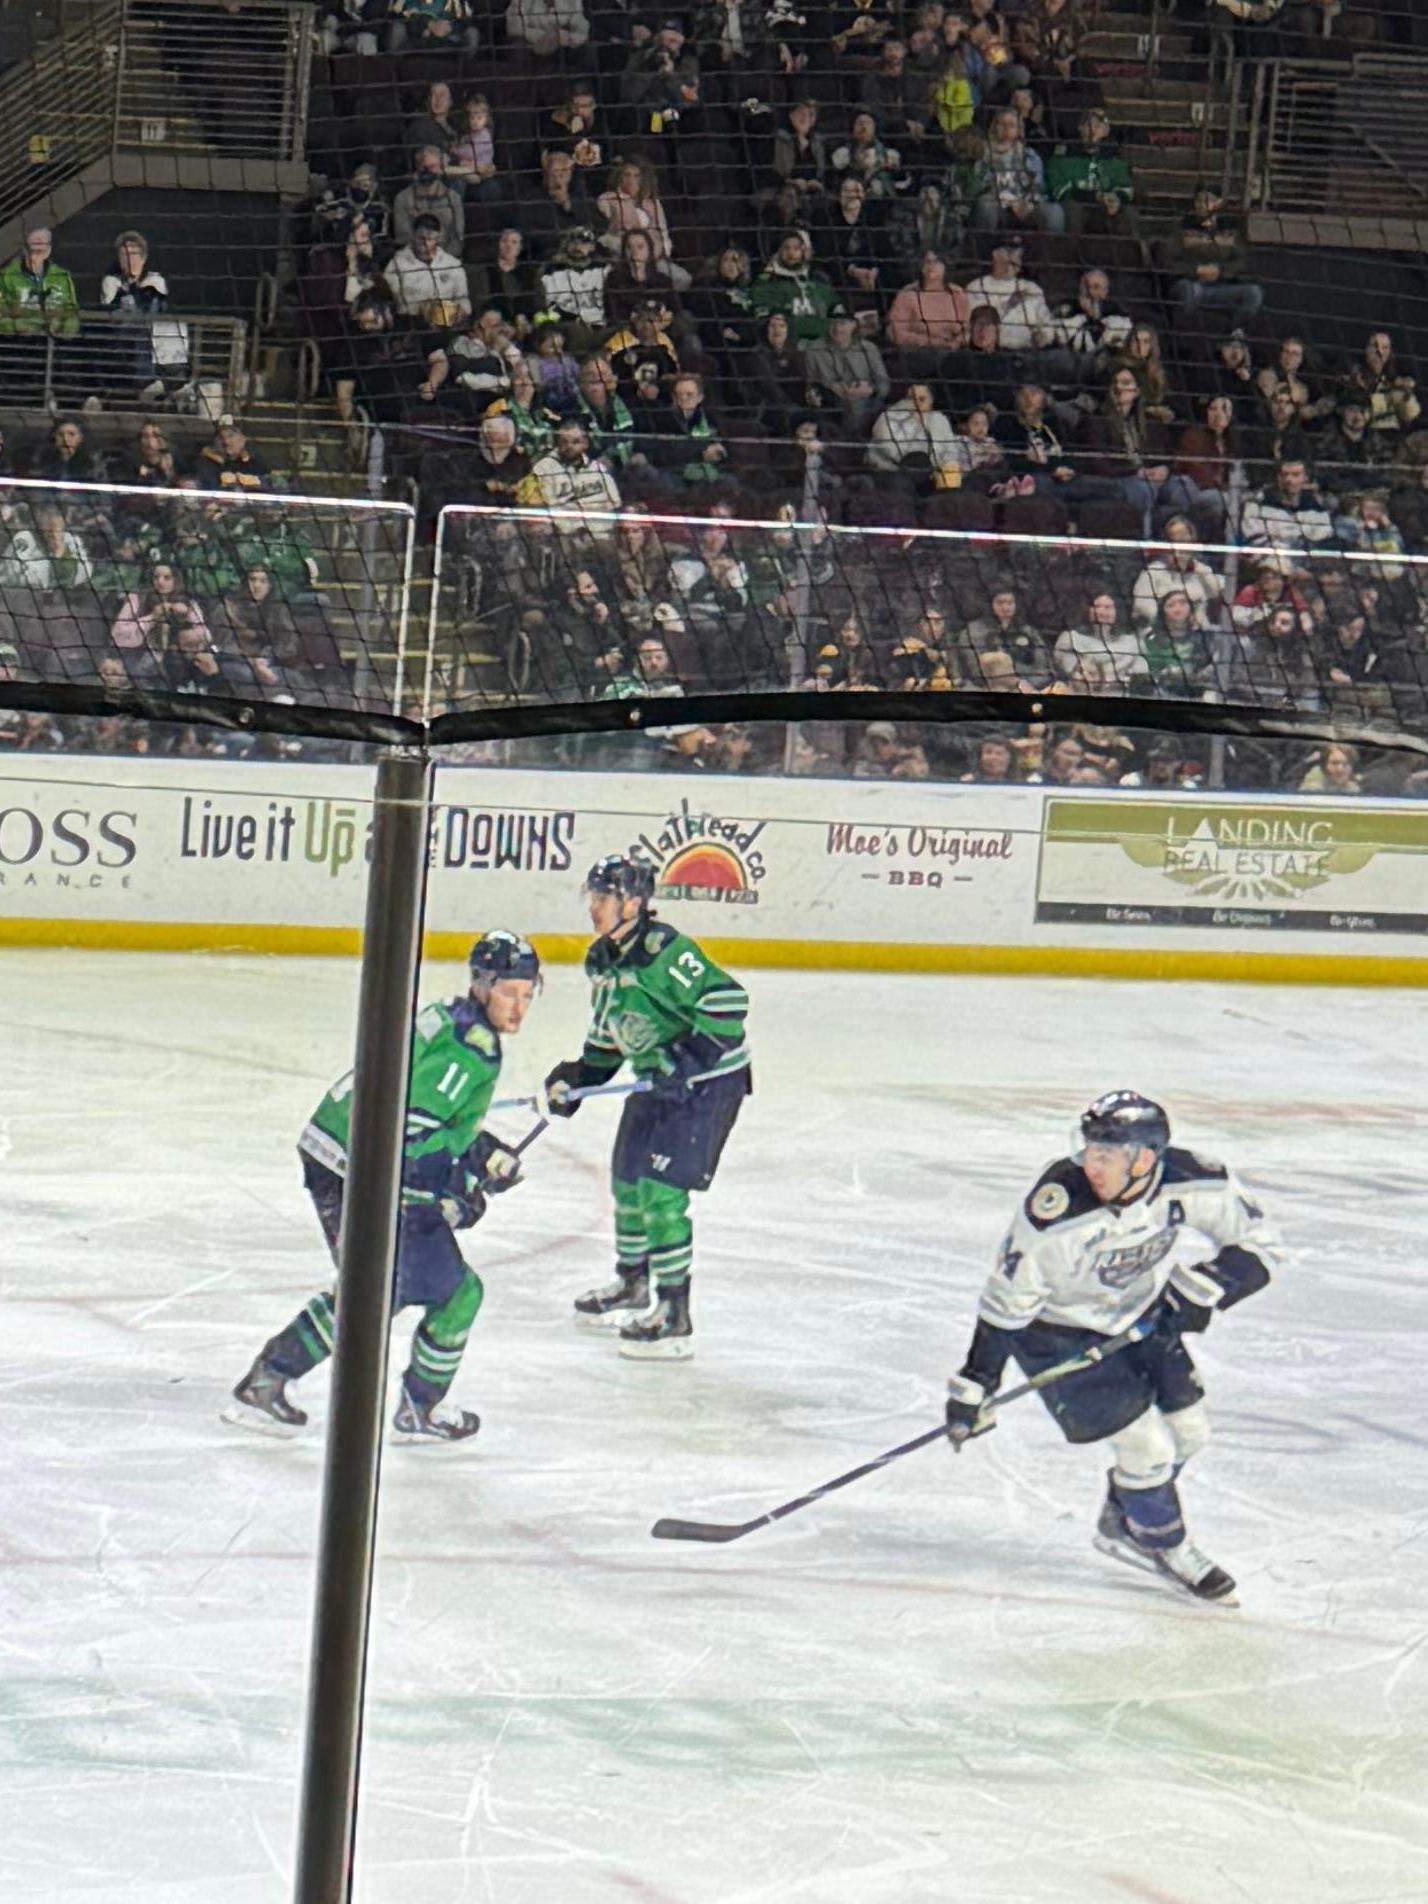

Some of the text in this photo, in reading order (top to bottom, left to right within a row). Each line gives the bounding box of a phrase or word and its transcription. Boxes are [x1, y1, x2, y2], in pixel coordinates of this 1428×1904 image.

[179, 795, 256, 862] Live
[264, 799, 297, 864] it
[304, 798, 357, 878] Up
[826, 822, 1014, 865] Moe's Original
[1166, 816, 1334, 846] LANDING
[887, 870, 944, 889] BBQ
[1162, 846, 1330, 876] REAL ESTATE
[668, 951, 706, 990] 13
[436, 1062, 469, 1102] 11
